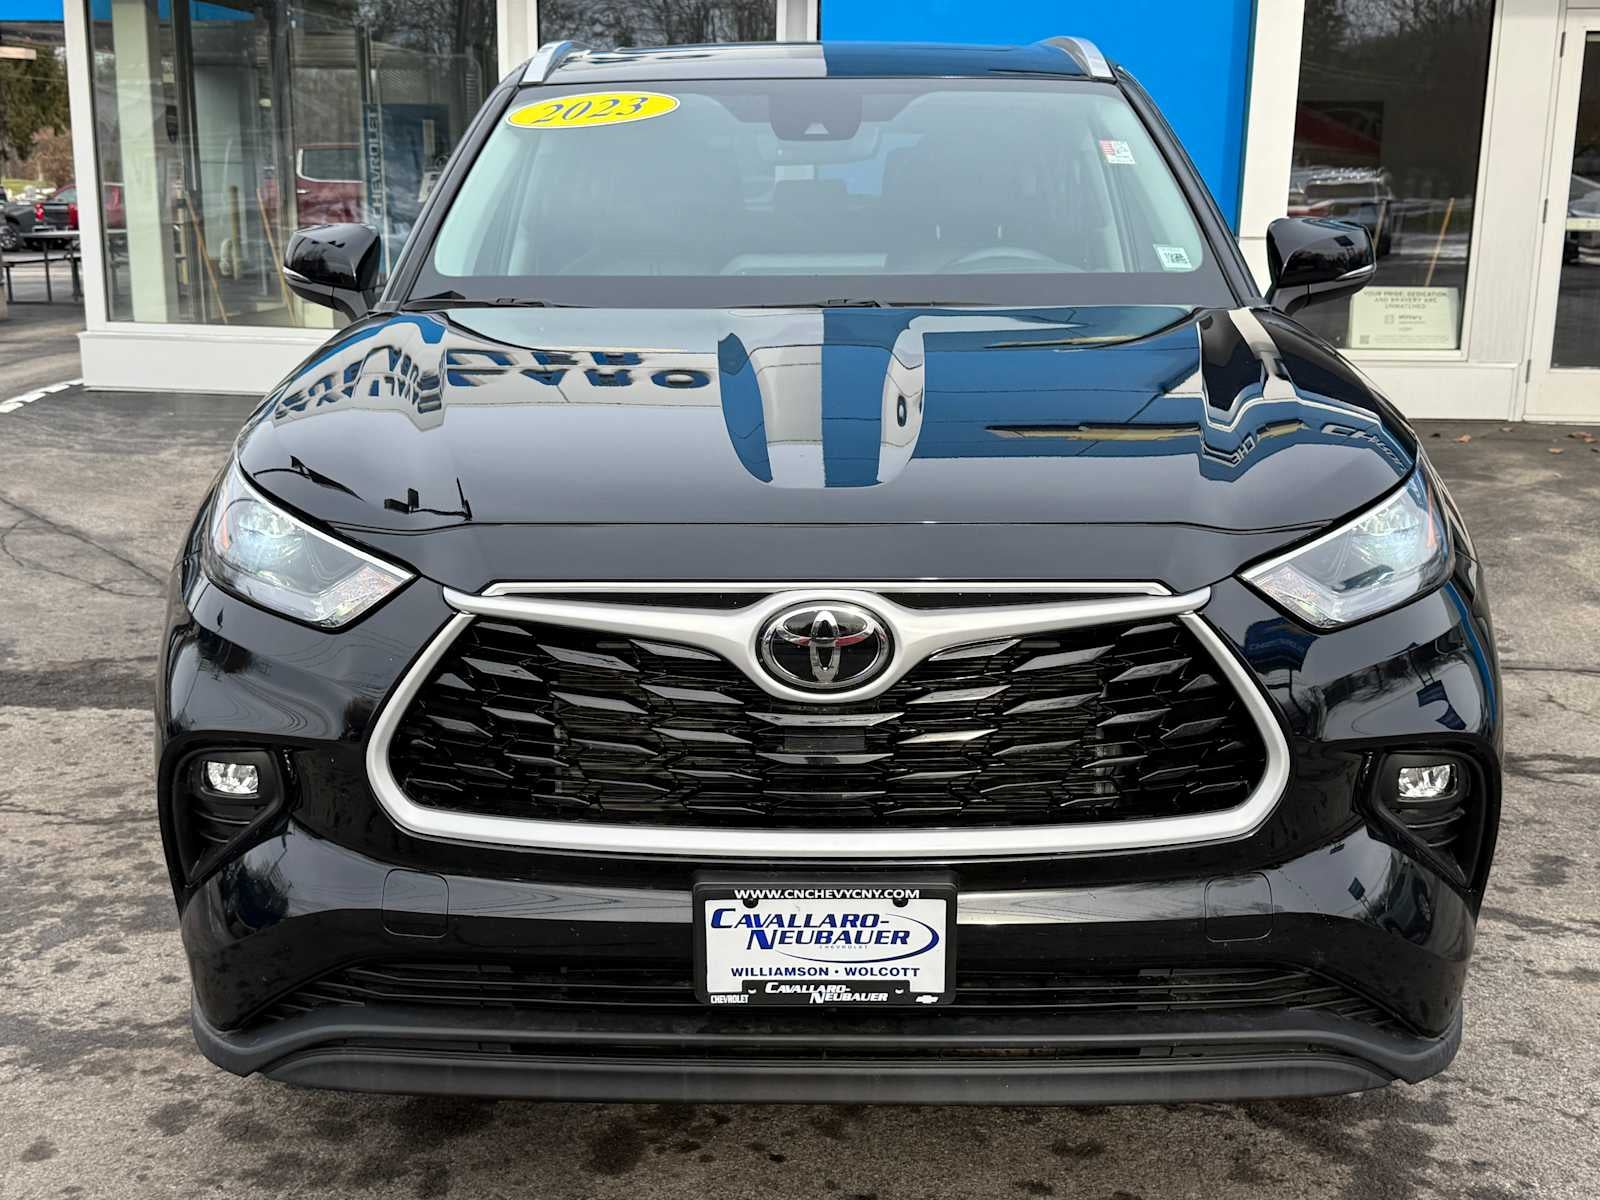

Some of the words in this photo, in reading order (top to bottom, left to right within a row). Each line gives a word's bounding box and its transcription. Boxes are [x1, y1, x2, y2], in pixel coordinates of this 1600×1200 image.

[531, 97, 649, 124] 2023
[367, 109, 382, 219] CHEVROLET
[734, 889, 920, 899] WWW.CNCHEVYCNY.COM
[711, 908, 889, 928] CAVALLARO-
[746, 929, 910, 950] NEUBAUER
[731, 967, 829, 977] WILLIAMSON
[844, 967, 920, 977] WOLCOTT
[710, 994, 749, 1004] CHEVROLET
[809, 991, 888, 1004] NEUBAUER
